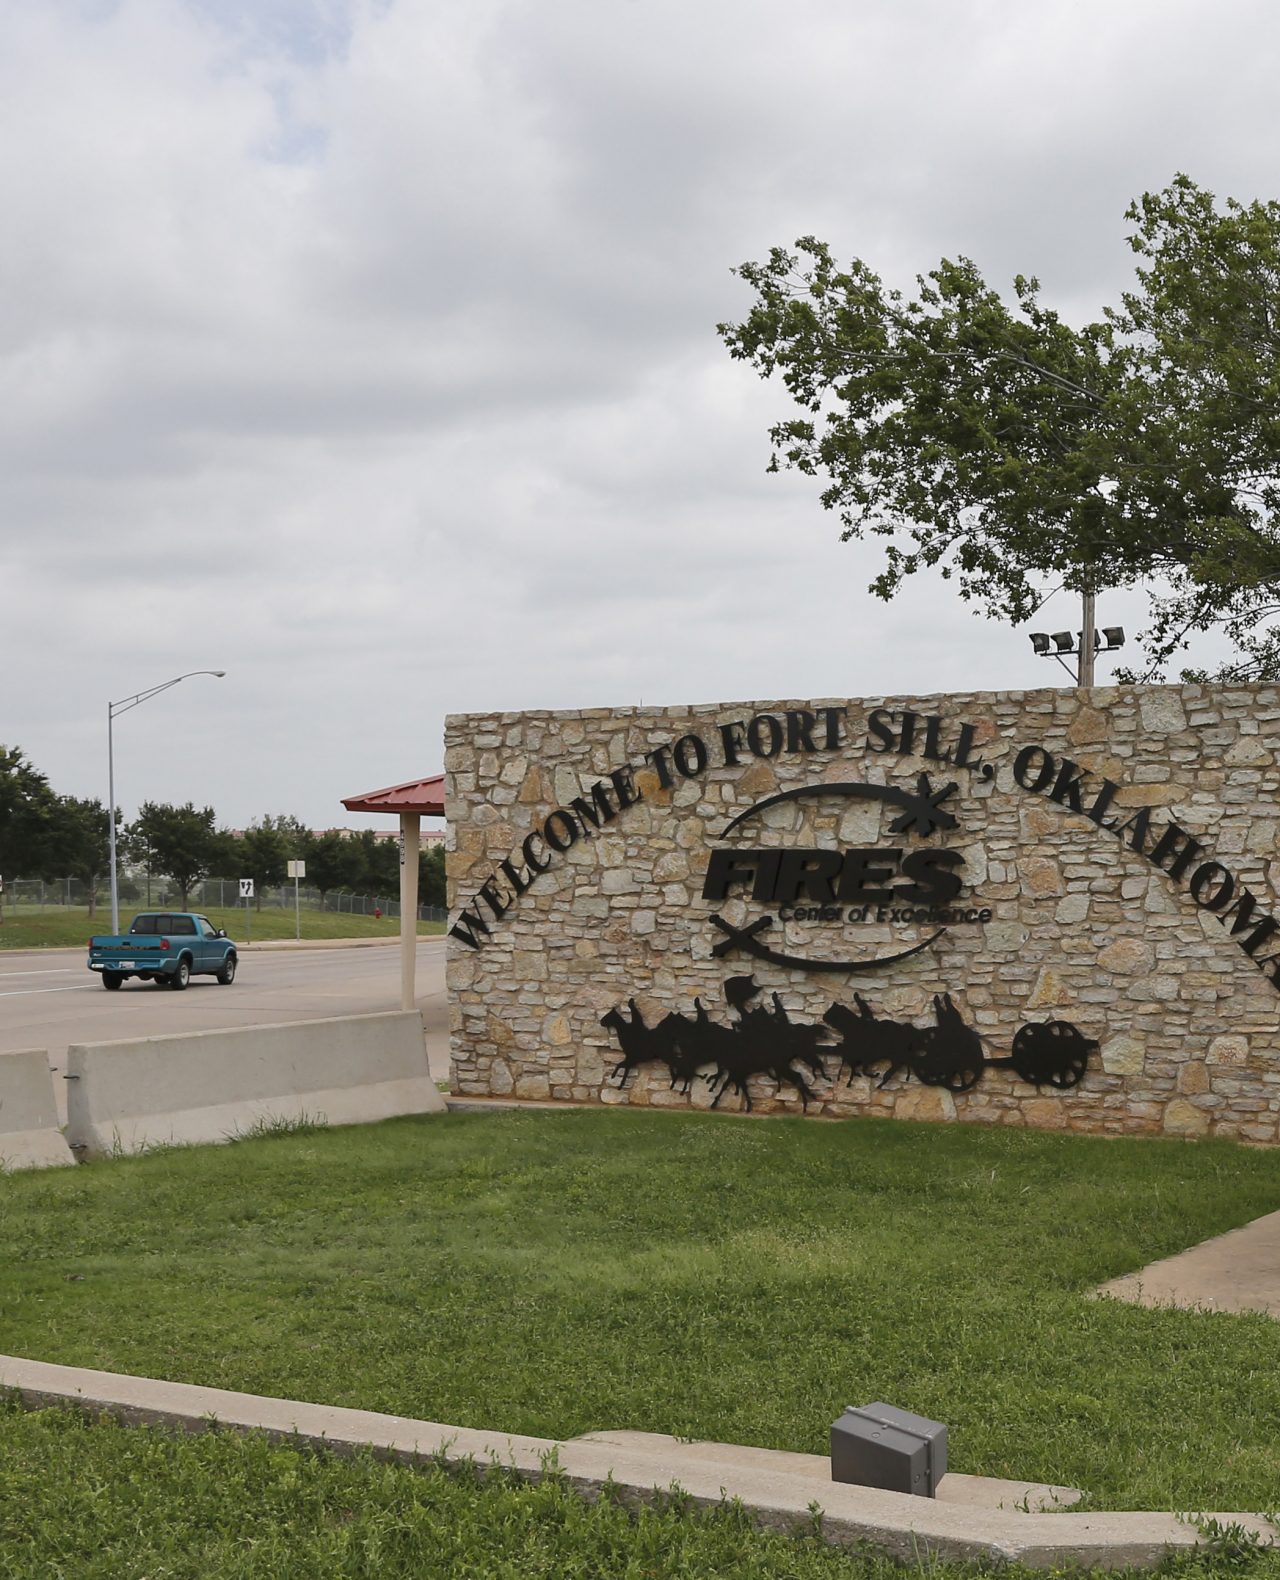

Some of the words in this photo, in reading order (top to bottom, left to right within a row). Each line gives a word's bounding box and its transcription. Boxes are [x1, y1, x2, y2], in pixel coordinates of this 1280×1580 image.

[448, 763, 643, 950] WELCOME
[644, 734, 707, 790] TO
[717, 707, 847, 766] FORT
[866, 709, 994, 783] SILL,
[702, 848, 966, 900] FIRES
[778, 903, 844, 922] Center
[848, 904, 870, 922] of
[876, 905, 993, 923] Excellence
